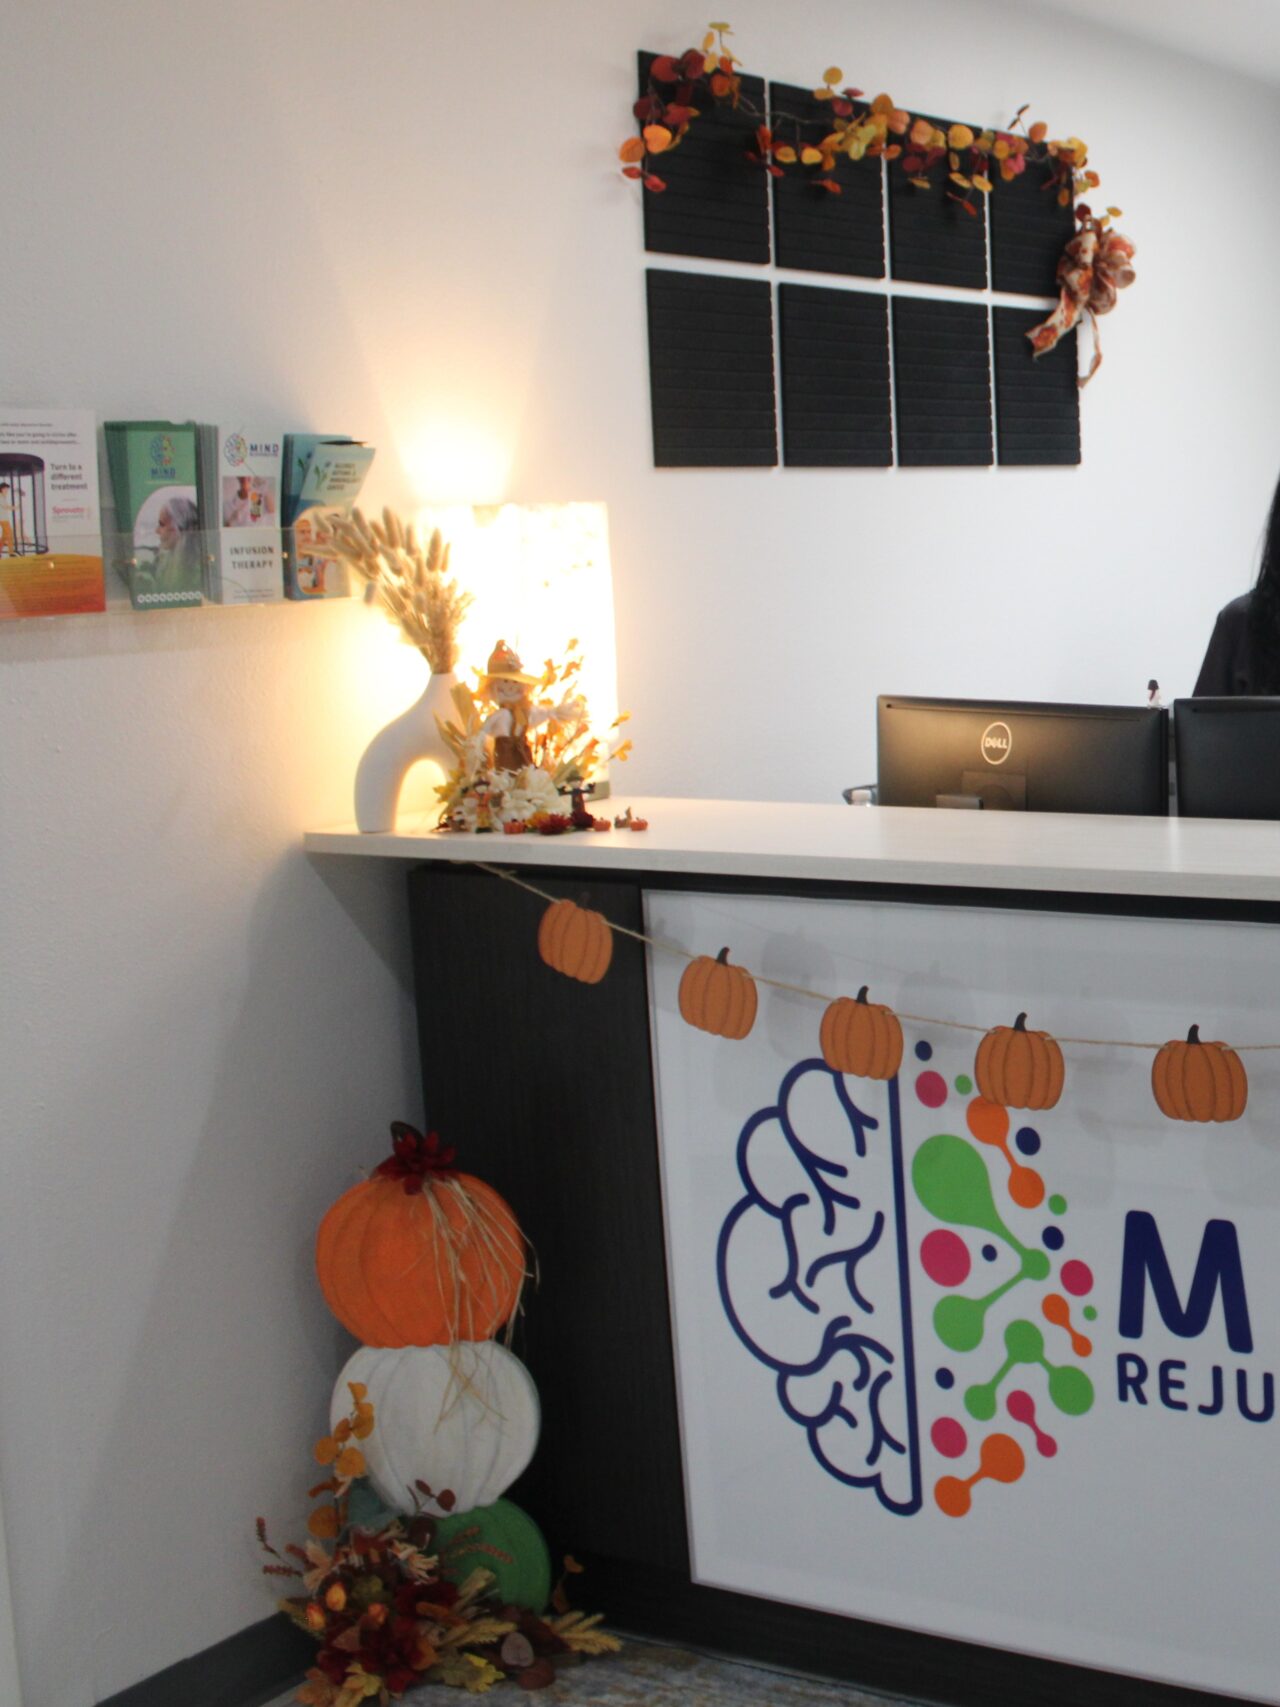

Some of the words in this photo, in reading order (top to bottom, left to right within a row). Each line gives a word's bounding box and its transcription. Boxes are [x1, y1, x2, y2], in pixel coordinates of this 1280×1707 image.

[249, 443, 279, 453] MIND
[50, 463, 68, 471] Turn
[51, 473, 82, 481] different
[230, 545, 274, 555] INFUSION
[232, 561, 273, 570] THERAPY
[985, 737, 1008, 748] DELL
